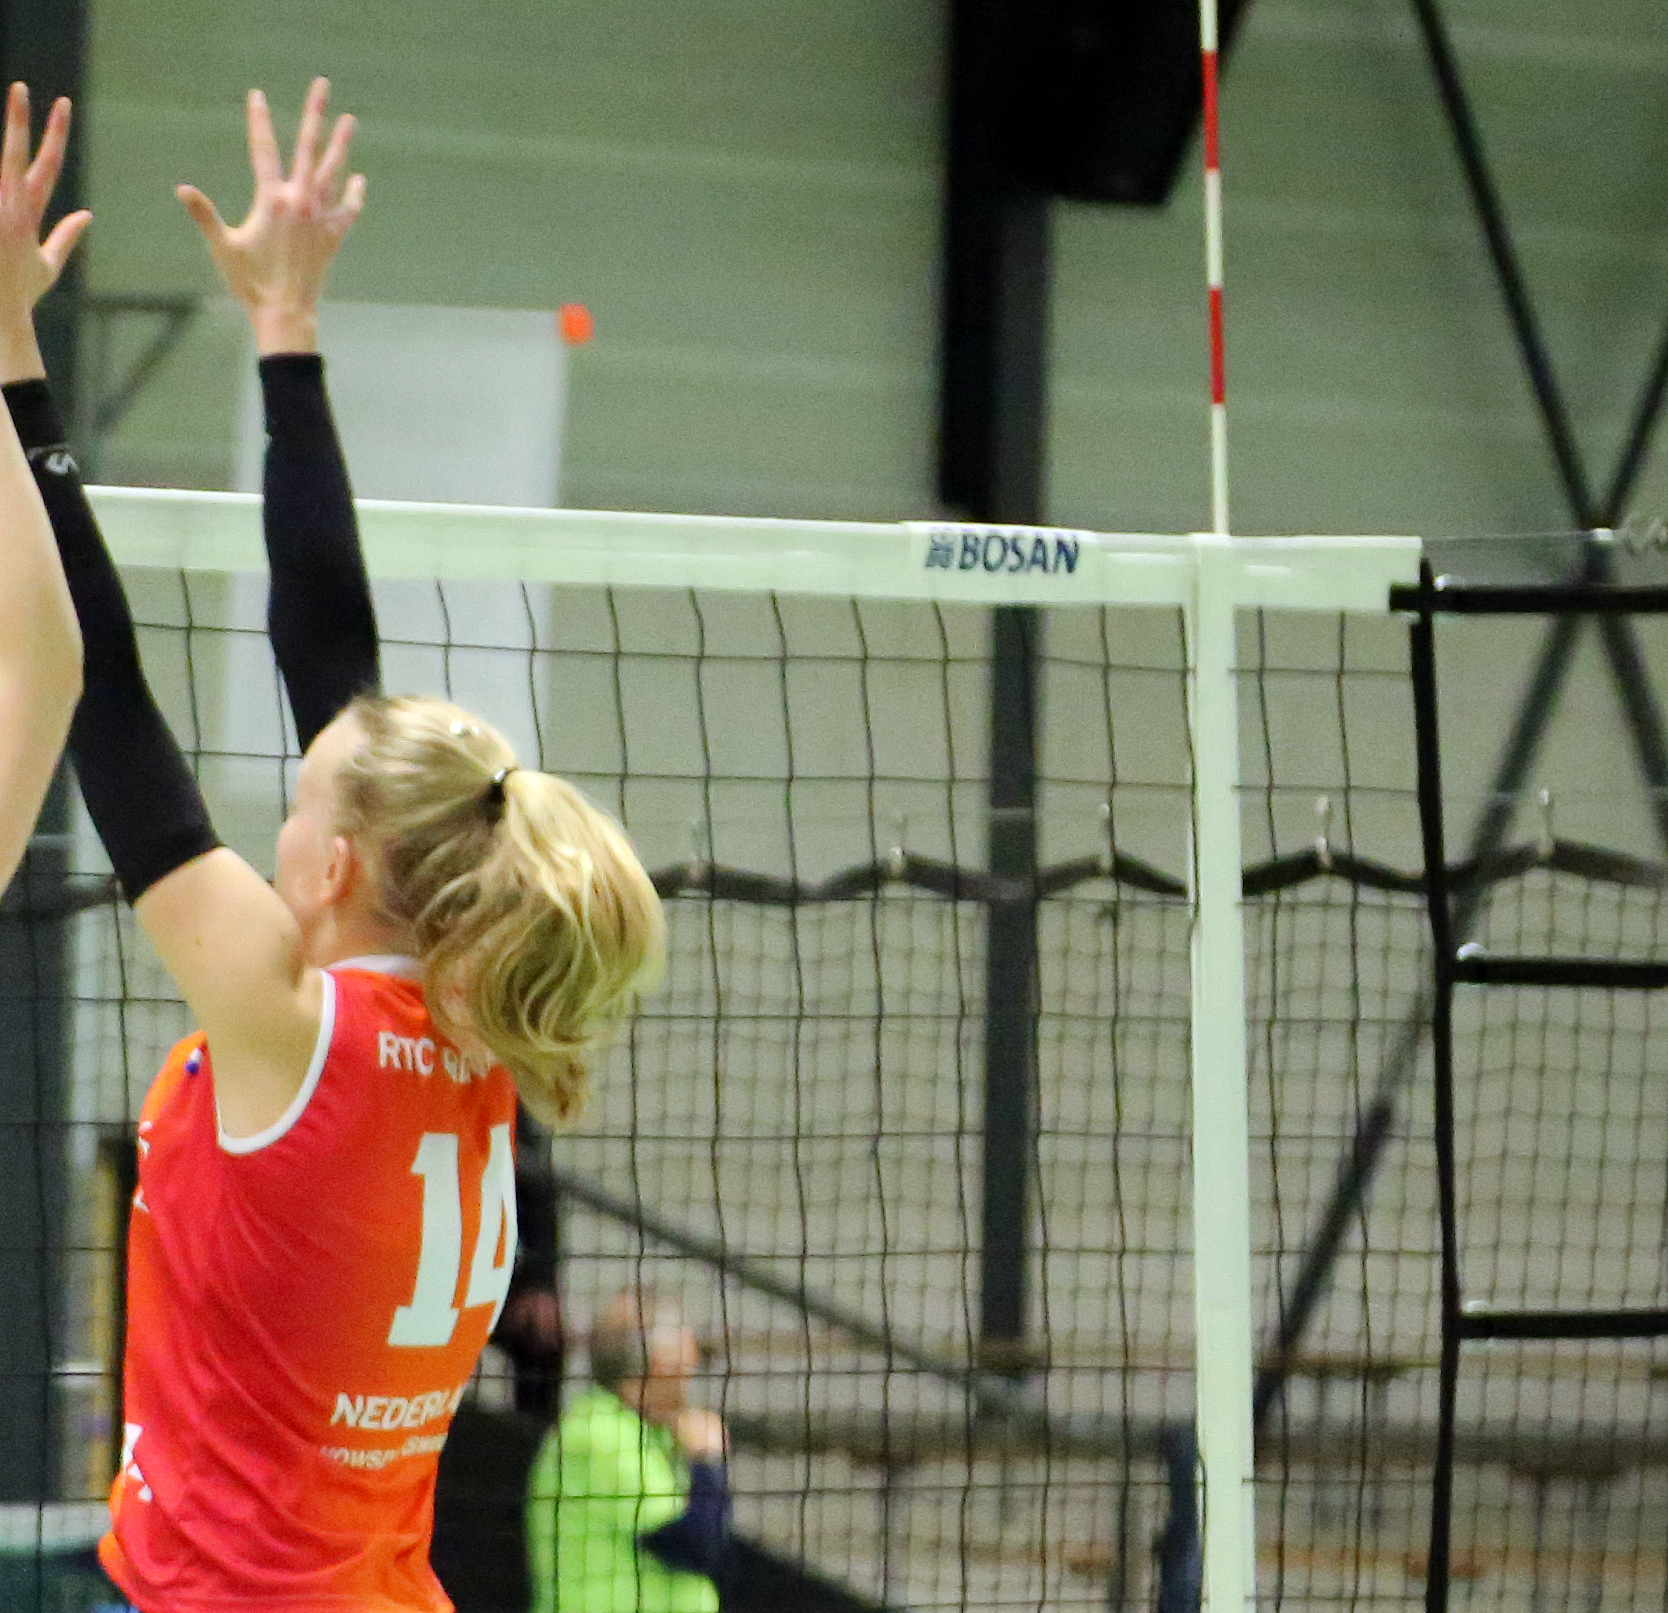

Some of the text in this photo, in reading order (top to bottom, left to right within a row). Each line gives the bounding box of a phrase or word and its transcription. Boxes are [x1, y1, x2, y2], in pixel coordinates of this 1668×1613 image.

[959, 530, 1079, 574] BOSAN
[378, 1030, 436, 1076] RTC
[388, 1123, 518, 1347] 14
